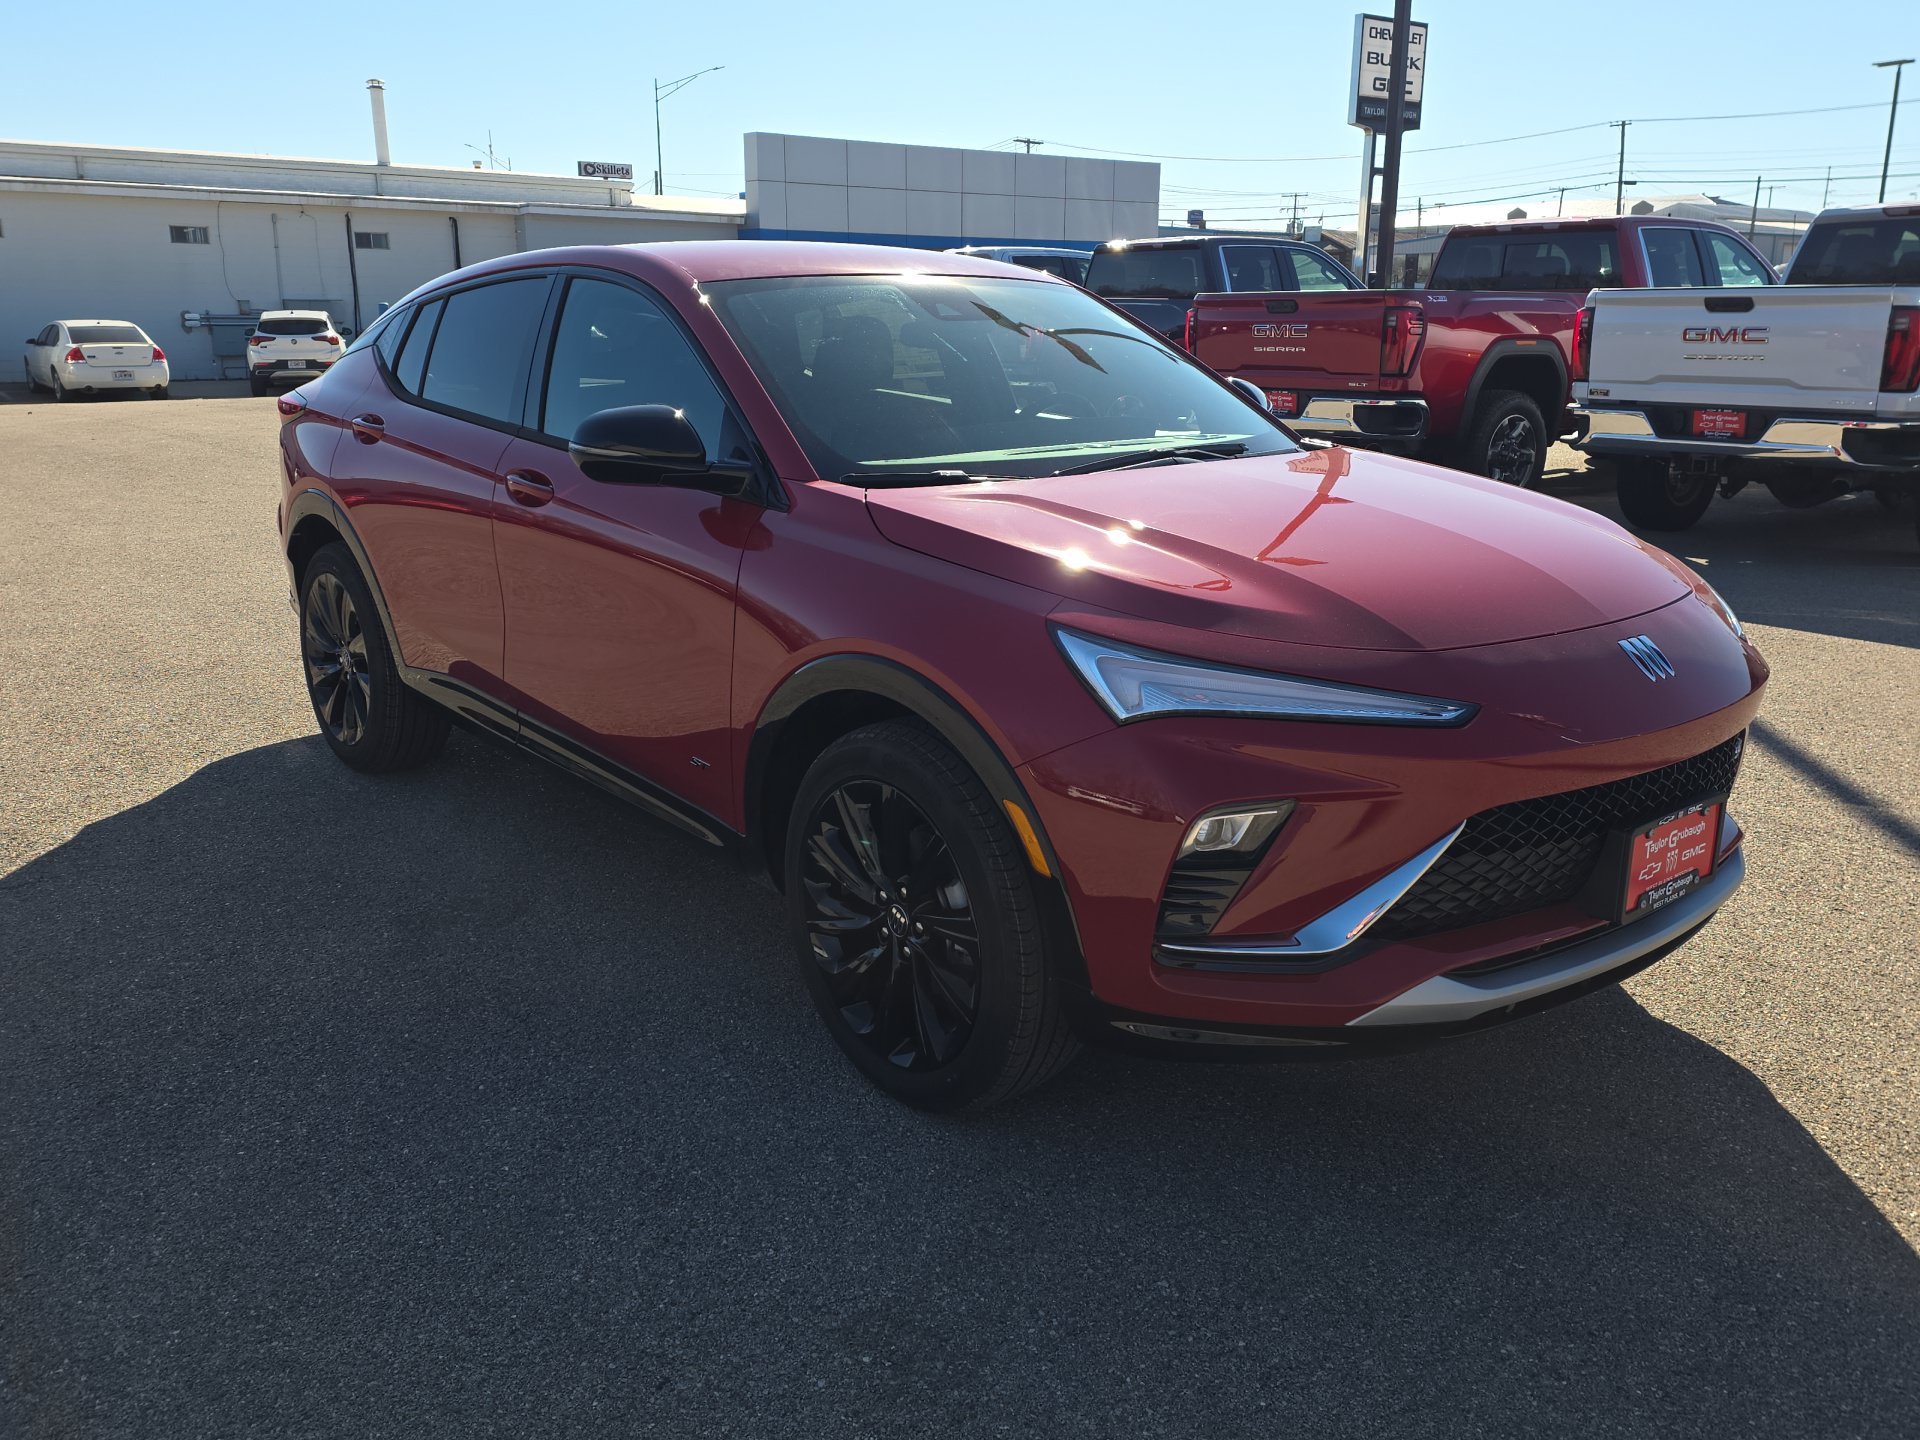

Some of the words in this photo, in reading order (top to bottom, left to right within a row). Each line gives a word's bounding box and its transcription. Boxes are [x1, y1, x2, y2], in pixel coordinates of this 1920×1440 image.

[1366, 51, 1421, 70] BUK
[1372, 76, 1413, 95] GC
[1364, 106, 1385, 116] TAYLOR
[596, 164, 630, 176] Skillets
[1252, 324, 1308, 338] GMC
[1682, 326, 1770, 344] GMC
[1645, 838, 1669, 859] Taylor
[1669, 820, 1706, 848] Grubaugh
[1681, 842, 1707, 861] GMC
[1648, 887, 1666, 904] Taylor
[1665, 873, 1694, 895] Grubaugh
